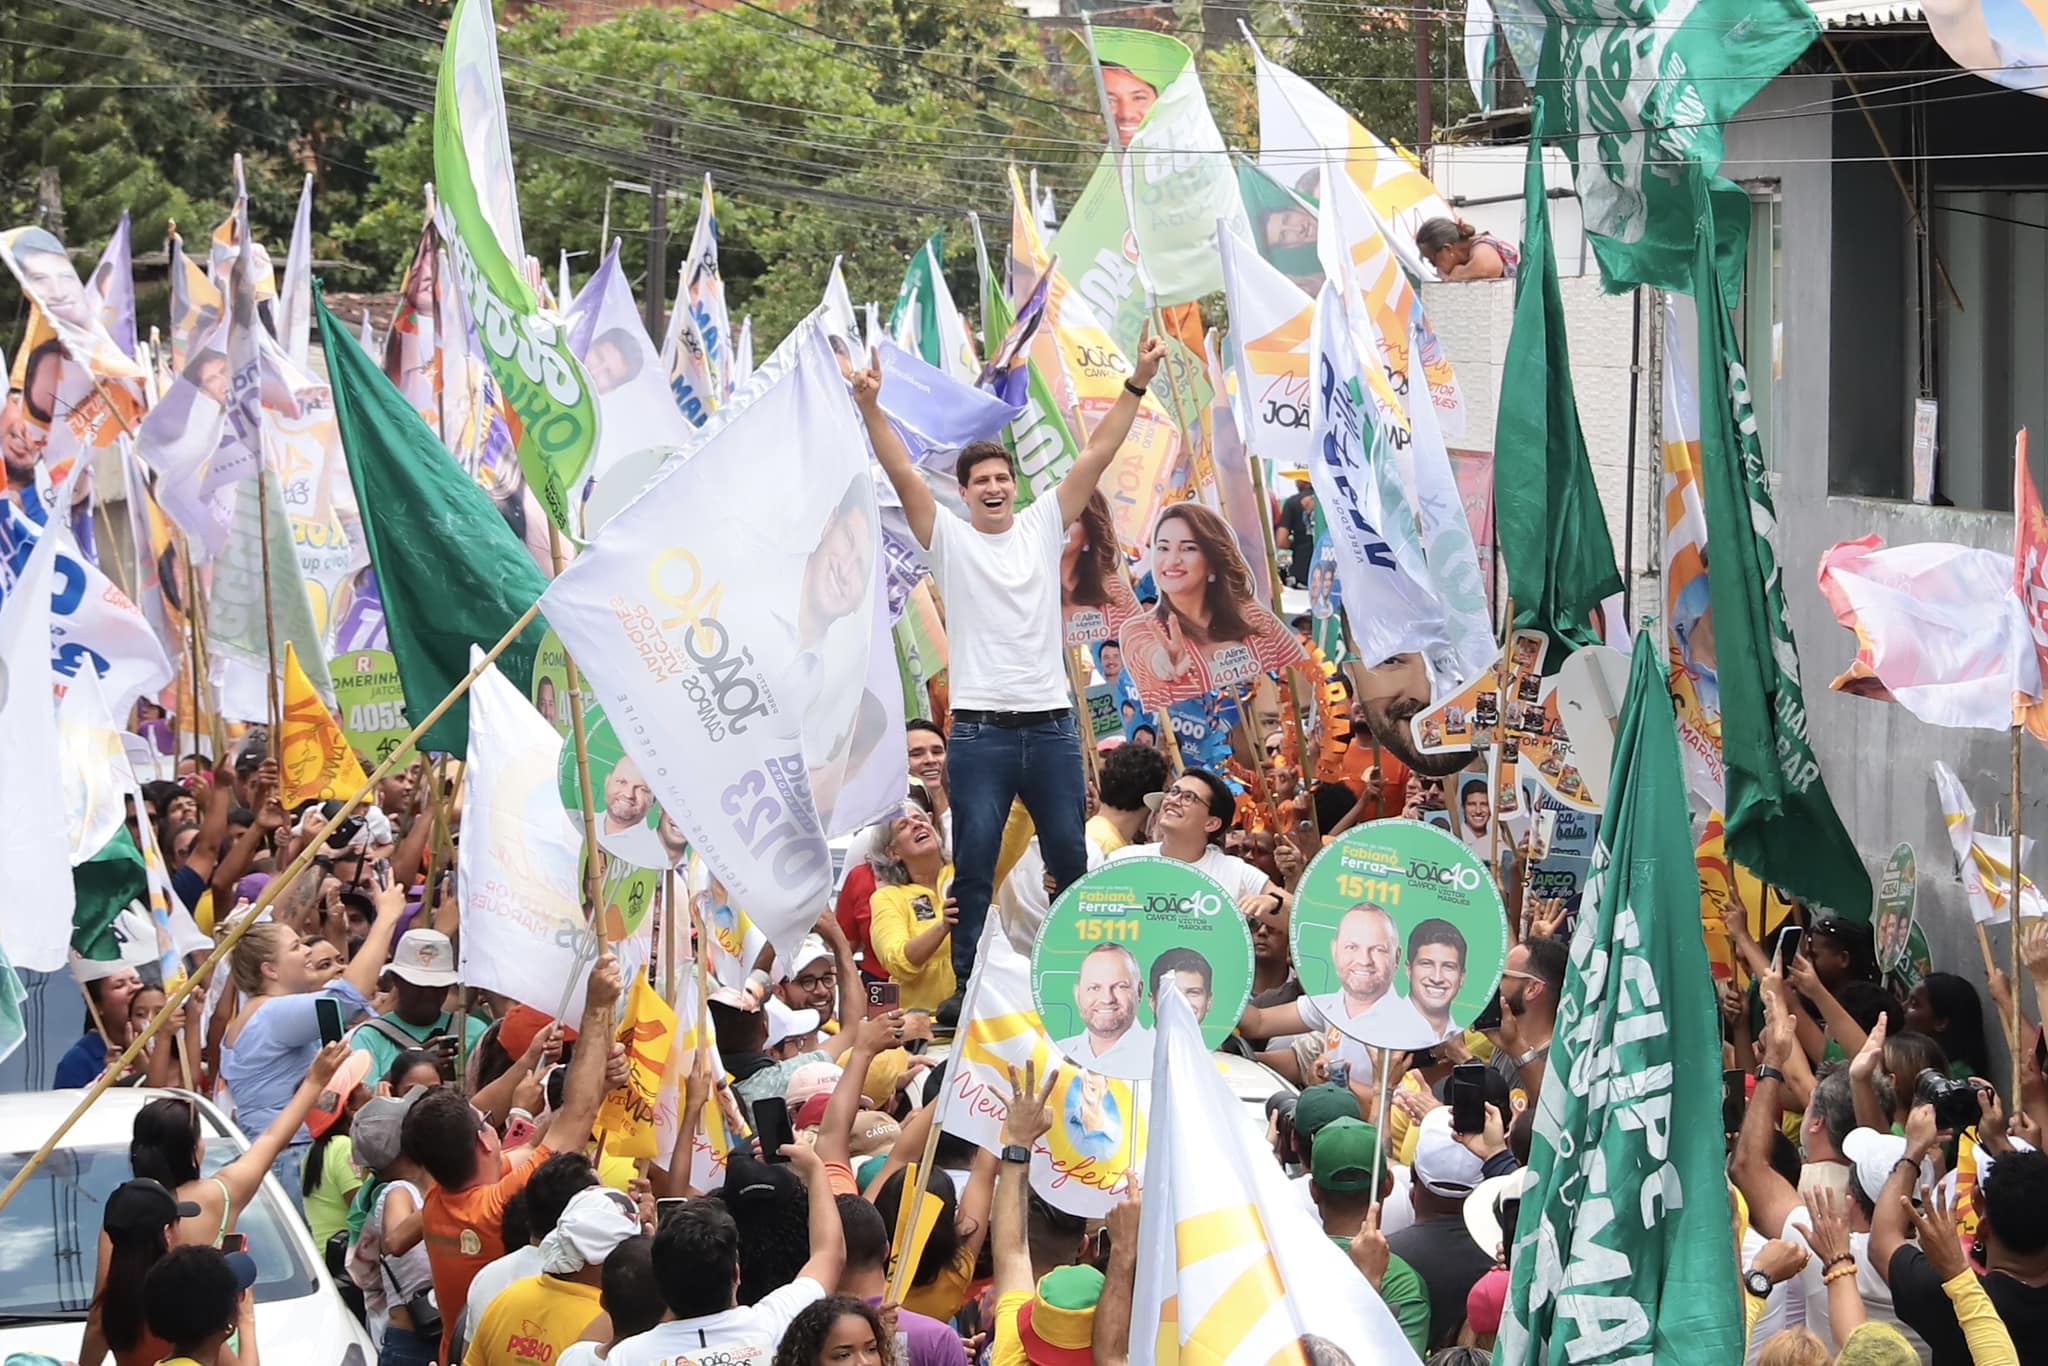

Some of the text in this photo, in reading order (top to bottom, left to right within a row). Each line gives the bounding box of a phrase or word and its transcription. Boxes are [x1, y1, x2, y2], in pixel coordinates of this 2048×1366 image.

[1263, 400, 1311, 431] JOÃ
[1081, 612, 1102, 622] Aline
[1068, 626, 1110, 643] 40140
[1225, 647, 1246, 658] Aline
[332, 672, 401, 689] OMERINH
[1214, 660, 1260, 683] 40140
[1555, 825, 1587, 840] bola
[1342, 846, 1399, 866] Fabiano
[1341, 856, 1388, 874] Ferraz
[1405, 861, 1453, 885] JOÃO
[1079, 888, 1136, 904] Fabiano
[1336, 874, 1437, 905] 15111 CAMPOS
[1437, 888, 1466, 899] VICTOR
[1078, 902, 1124, 913] Ferraz
[1144, 893, 1193, 914] JOÃO
[1075, 914, 1177, 941] 15111 CAMPOS
[953, 1071, 1008, 1122] Meu
